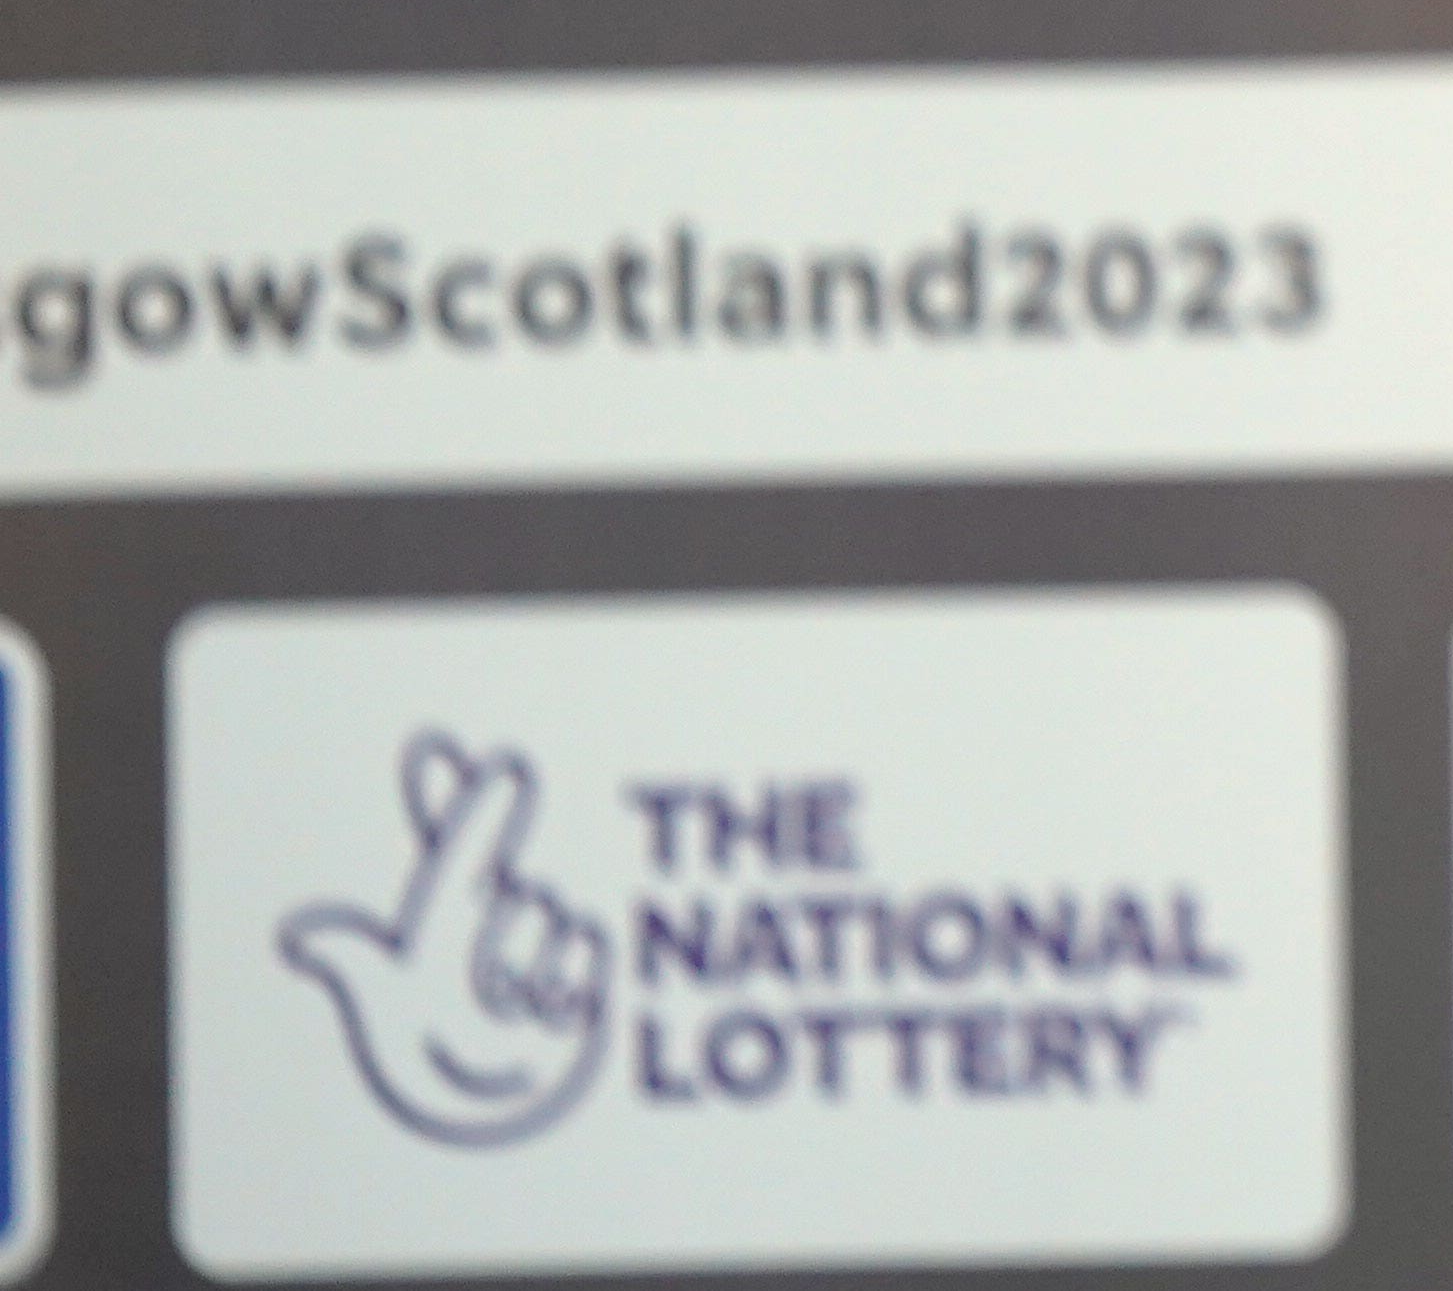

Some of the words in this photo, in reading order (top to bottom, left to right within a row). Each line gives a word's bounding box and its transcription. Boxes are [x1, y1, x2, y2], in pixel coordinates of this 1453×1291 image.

[624, 778, 860, 876] THE
[635, 883, 1240, 984] NATIONAL
[635, 1011, 1170, 1104] LOTTERY
